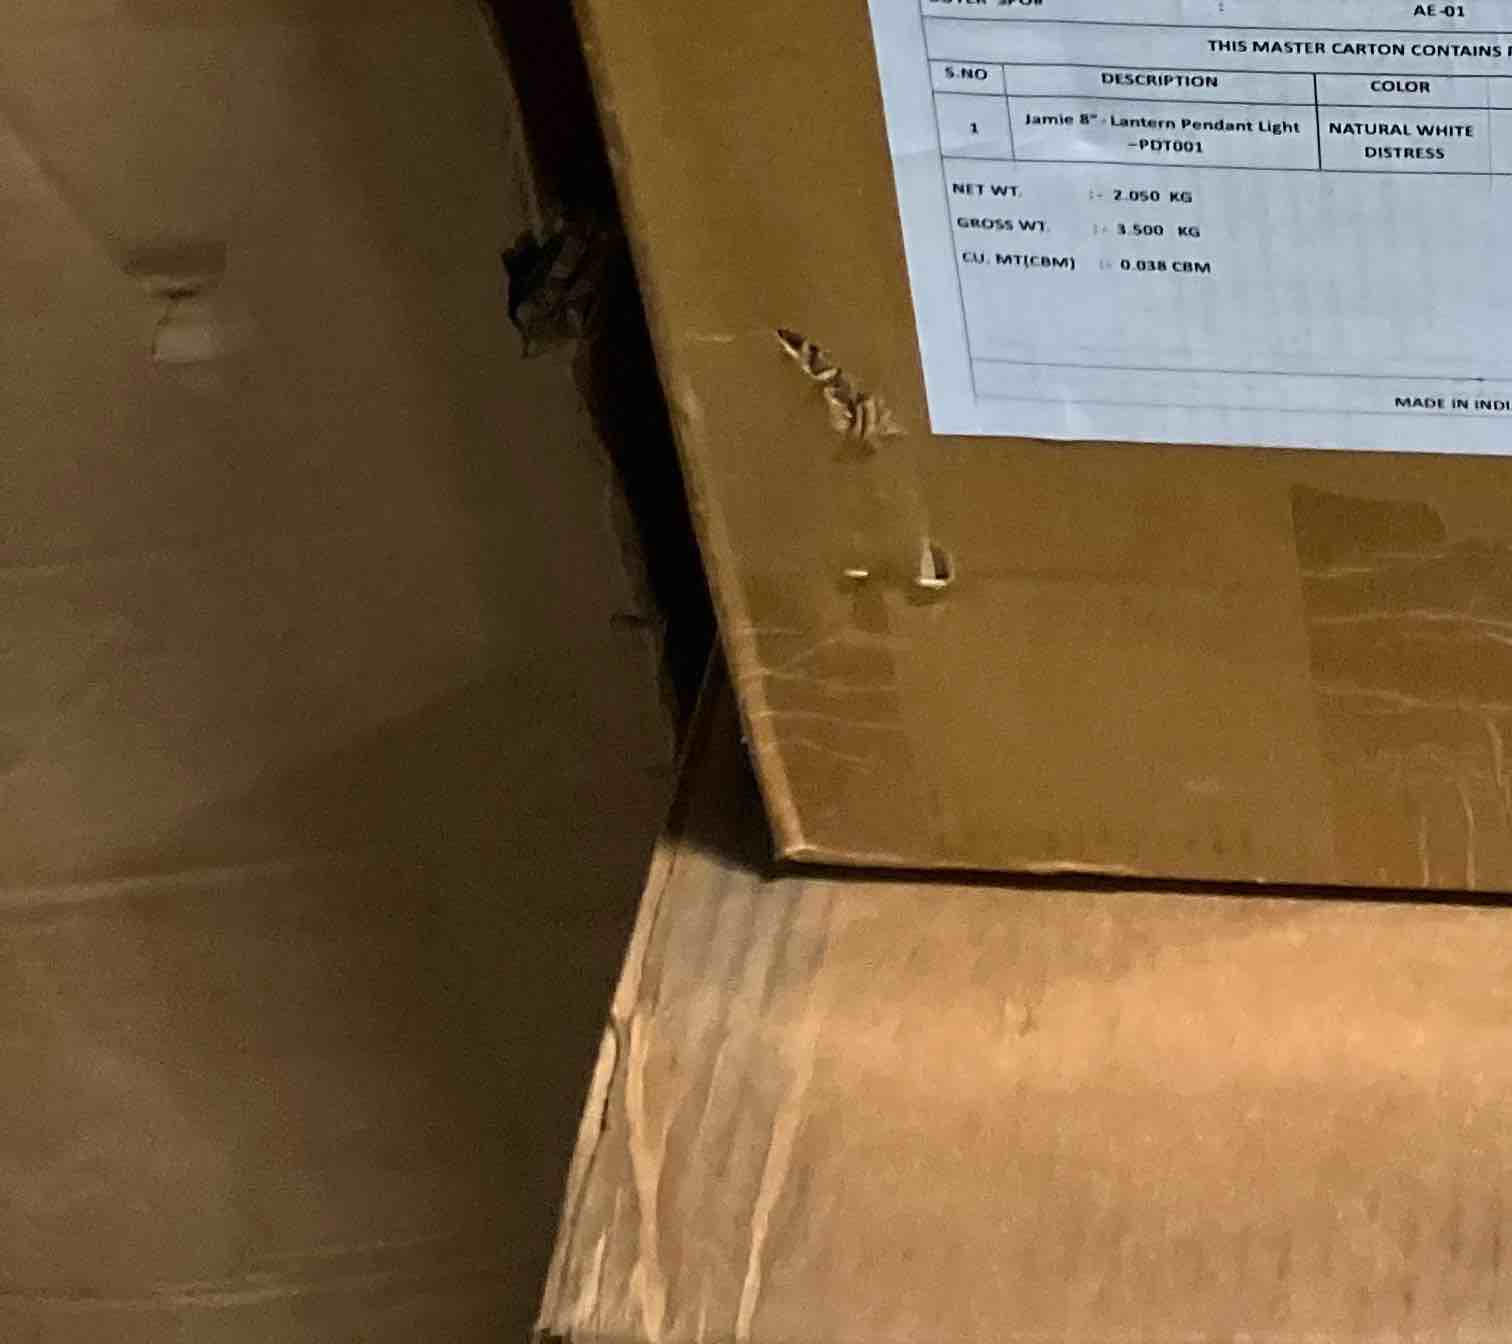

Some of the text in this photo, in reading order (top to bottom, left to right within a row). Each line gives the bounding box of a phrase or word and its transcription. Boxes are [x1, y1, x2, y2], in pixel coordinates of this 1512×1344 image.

[1208, 39, 1247, 53] THIS
[1252, 40, 1326, 55] MASTER
[1331, 42, 1405, 57] CARTON
[1410, 43, 1502, 58] CONTAINS
[944, 67, 988, 80] S.NO
[1101, 72, 1218, 87] DESCRIPTION
[1370, 79, 1430, 94] COLOR
[1025, 113, 1074, 125] Jamie
[1110, 115, 1176, 130] Lantern
[1181, 117, 1252, 132] Pendant
[1258, 120, 1300, 136] Light
[1328, 122, 1474, 138] NATURAL WHITE
[1364, 146, 1445, 160] DISTRESS
[952, 183, 984, 196] NET
[1113, 189, 1160, 202] 2.050
[1169, 191, 1193, 203] KG
[956, 216, 1014, 231] GROSS
[1117, 223, 1164, 236] 3.500
[1177, 225, 1201, 238] KG
[995, 253, 1076, 270] MT(CBM)
[1120, 259, 1167, 272] 0.038
[1172, 261, 1212, 274] CBM
[1395, 397, 1445, 409] MADE
[1452, 398, 1469, 409] IN
